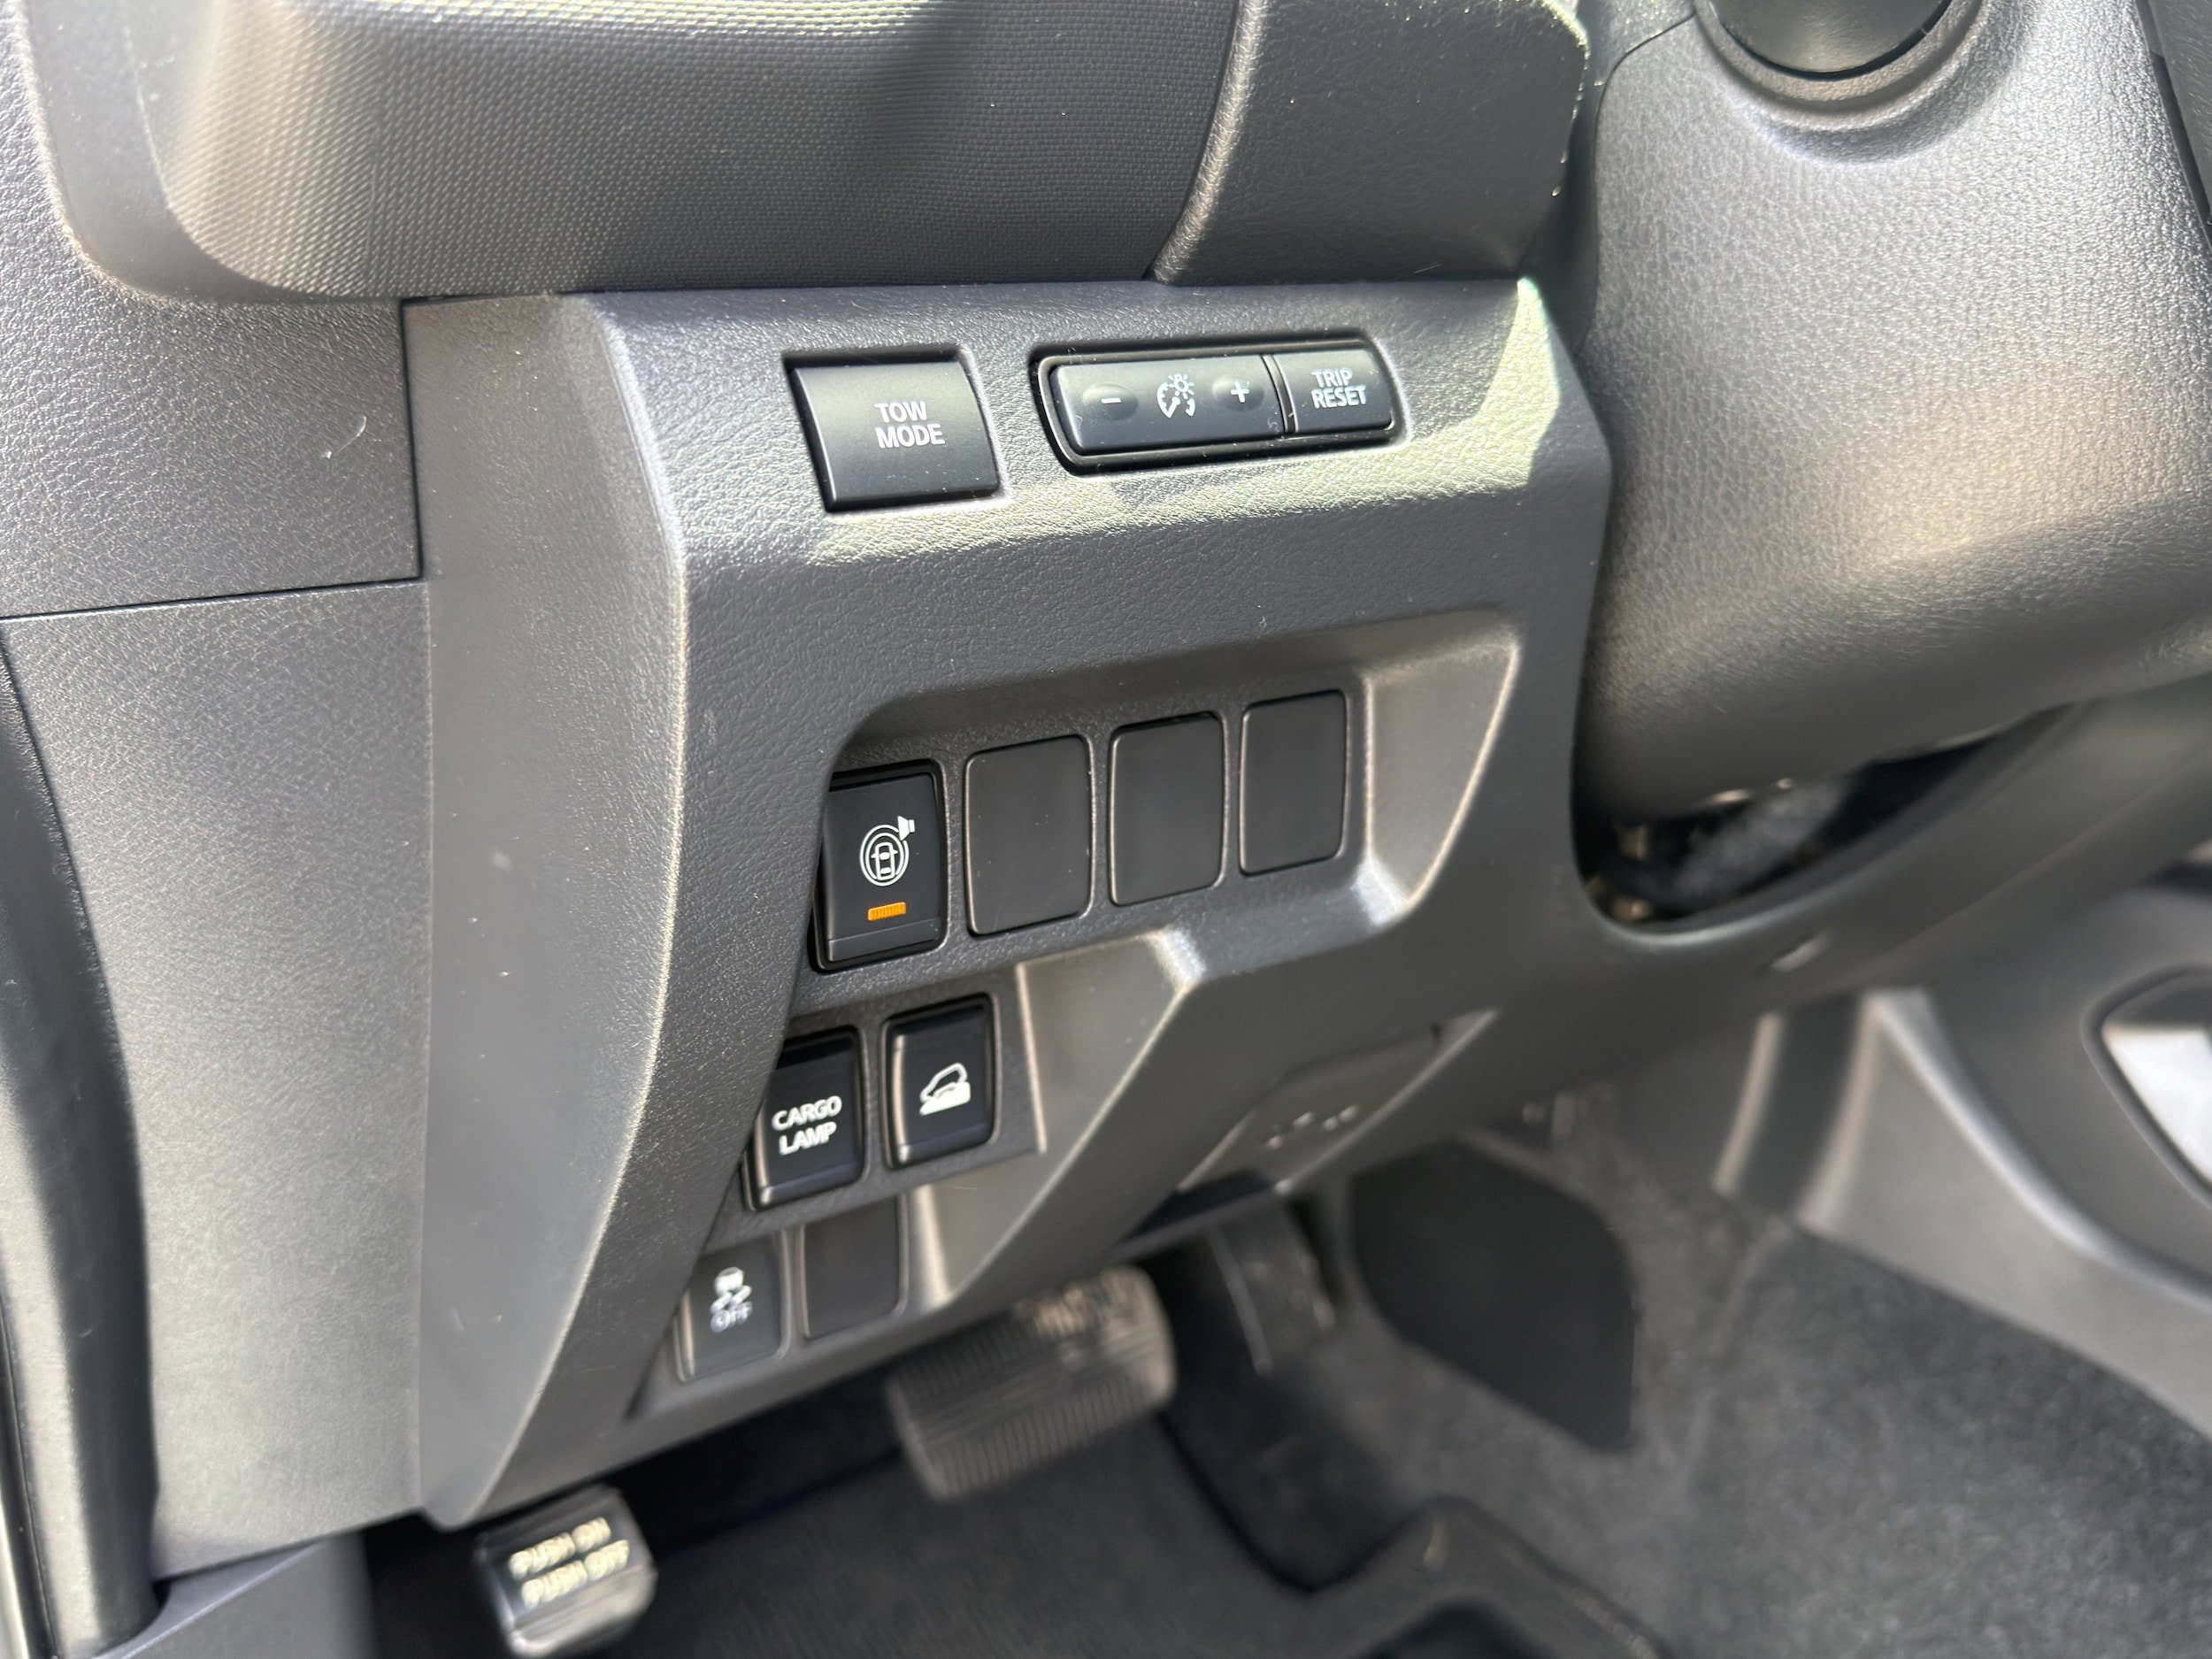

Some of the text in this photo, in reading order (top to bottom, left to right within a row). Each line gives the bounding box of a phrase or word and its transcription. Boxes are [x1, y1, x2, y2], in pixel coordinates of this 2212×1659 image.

[1311, 367, 1353, 388] TRIP
[1310, 385, 1366, 409] RESET
[874, 401, 926, 423] TOW
[875, 424, 946, 449] MODE
[772, 1095, 842, 1131] CARGO
[779, 1121, 837, 1156] LAMP
